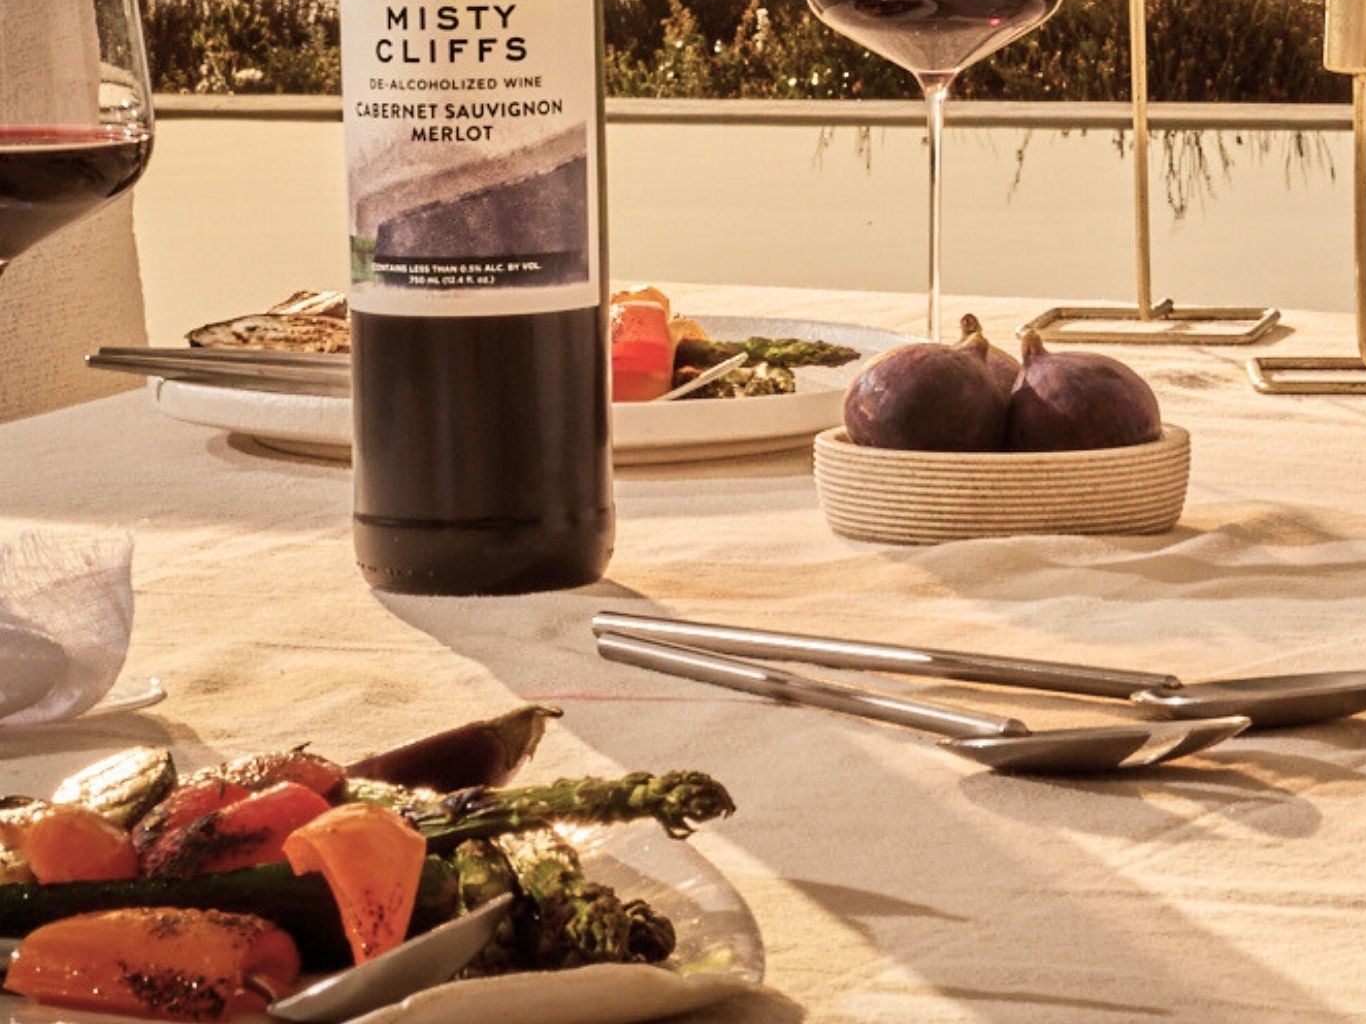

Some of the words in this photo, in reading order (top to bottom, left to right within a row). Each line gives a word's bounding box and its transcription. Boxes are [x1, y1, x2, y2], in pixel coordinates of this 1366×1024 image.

[386, 4, 517, 31] MISTY
[375, 36, 528, 64] CLIFFS
[369, 78, 498, 90] DE-ALCOHOLIZED
[503, 76, 542, 88] WINE
[356, 101, 438, 119] CABERNET
[444, 98, 563, 119] SAUVIGNON
[411, 125, 494, 142] MERLOT
[408, 263, 430, 273] LESS
[432, 263, 458, 273] THAN
